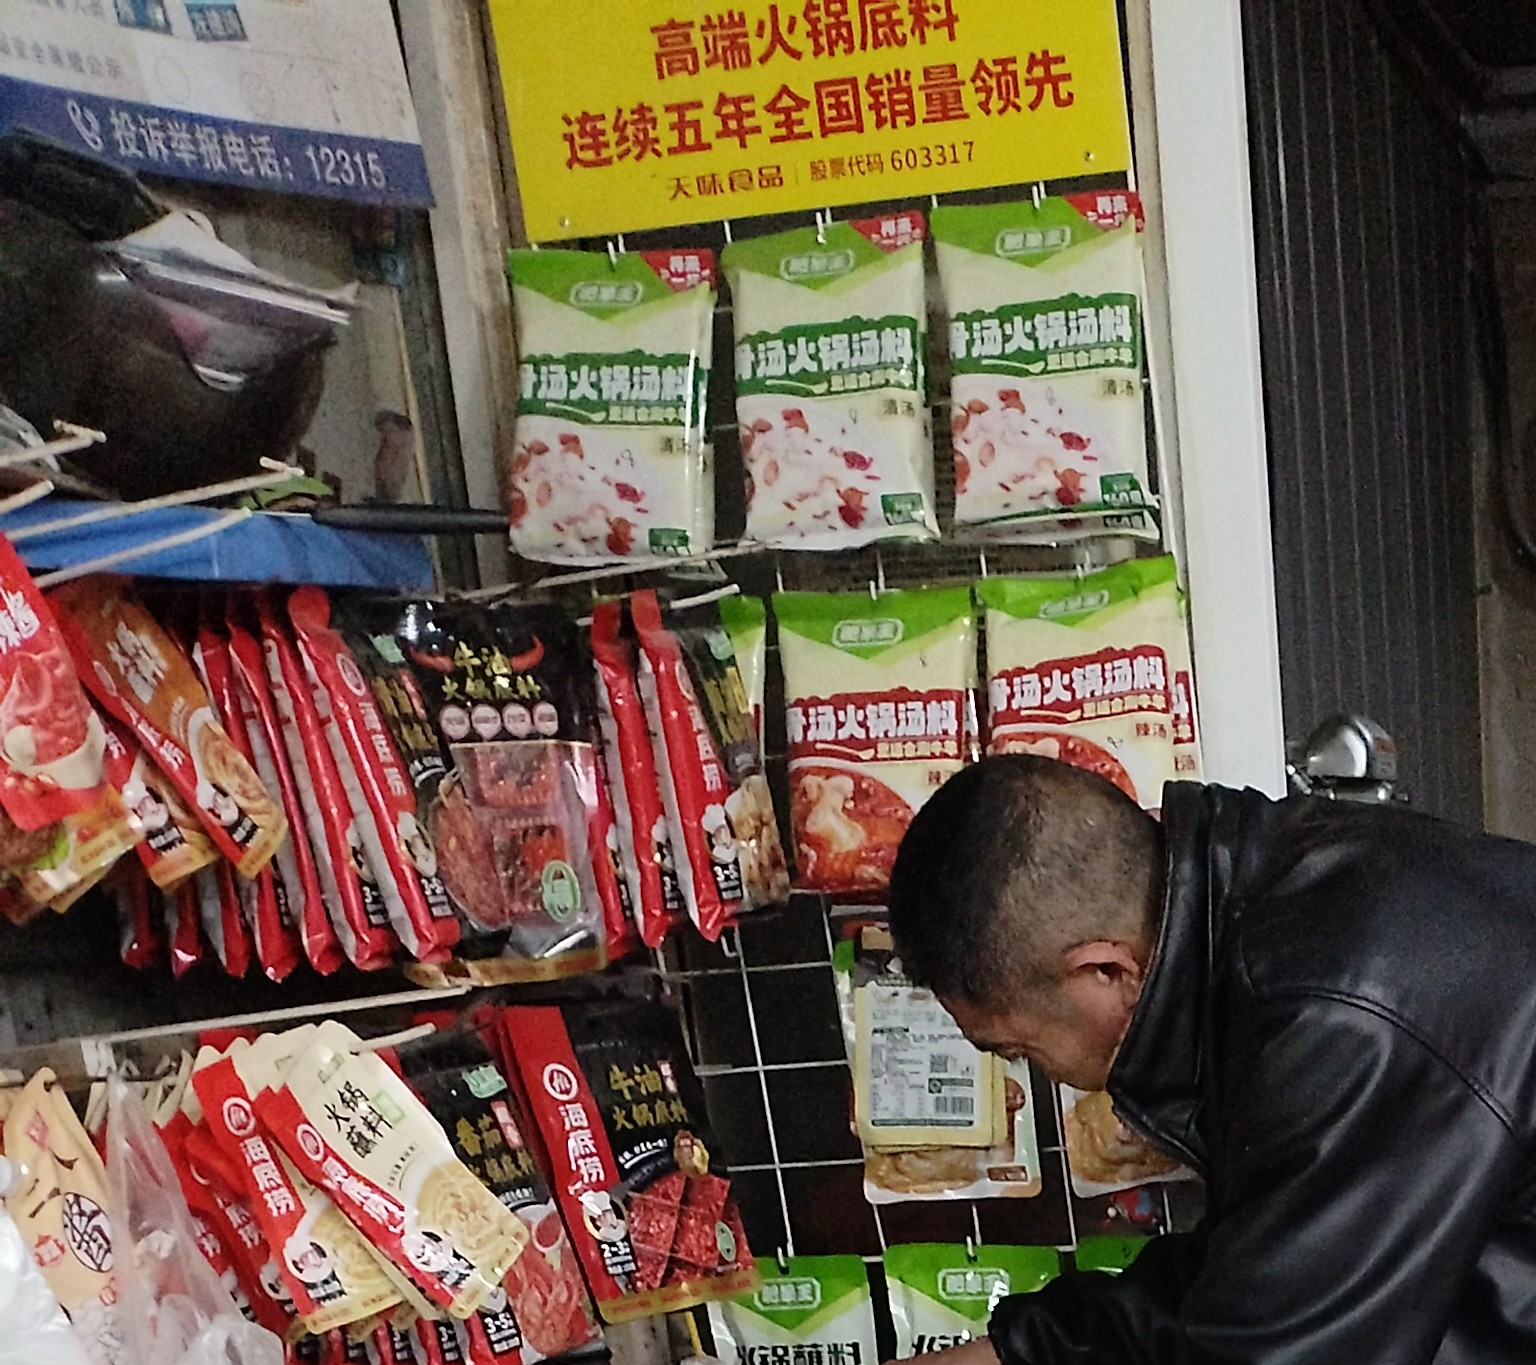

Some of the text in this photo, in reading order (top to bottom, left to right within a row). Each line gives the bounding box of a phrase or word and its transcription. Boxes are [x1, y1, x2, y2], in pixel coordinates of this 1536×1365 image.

[650, 0, 959, 80] 高端火锅底料
[561, 50, 1074, 169] 连续五年全国销量领先
[669, 141, 974, 200] 天味食品 股票代码 603317
[323, 1081, 370, 1133] 火锅
[609, 1062, 663, 1100] 牛油
[612, 1097, 689, 1131] 火锅底料
[239, 1135, 296, 1217] 海底捞
[558, 1102, 605, 1184] 海底捞
